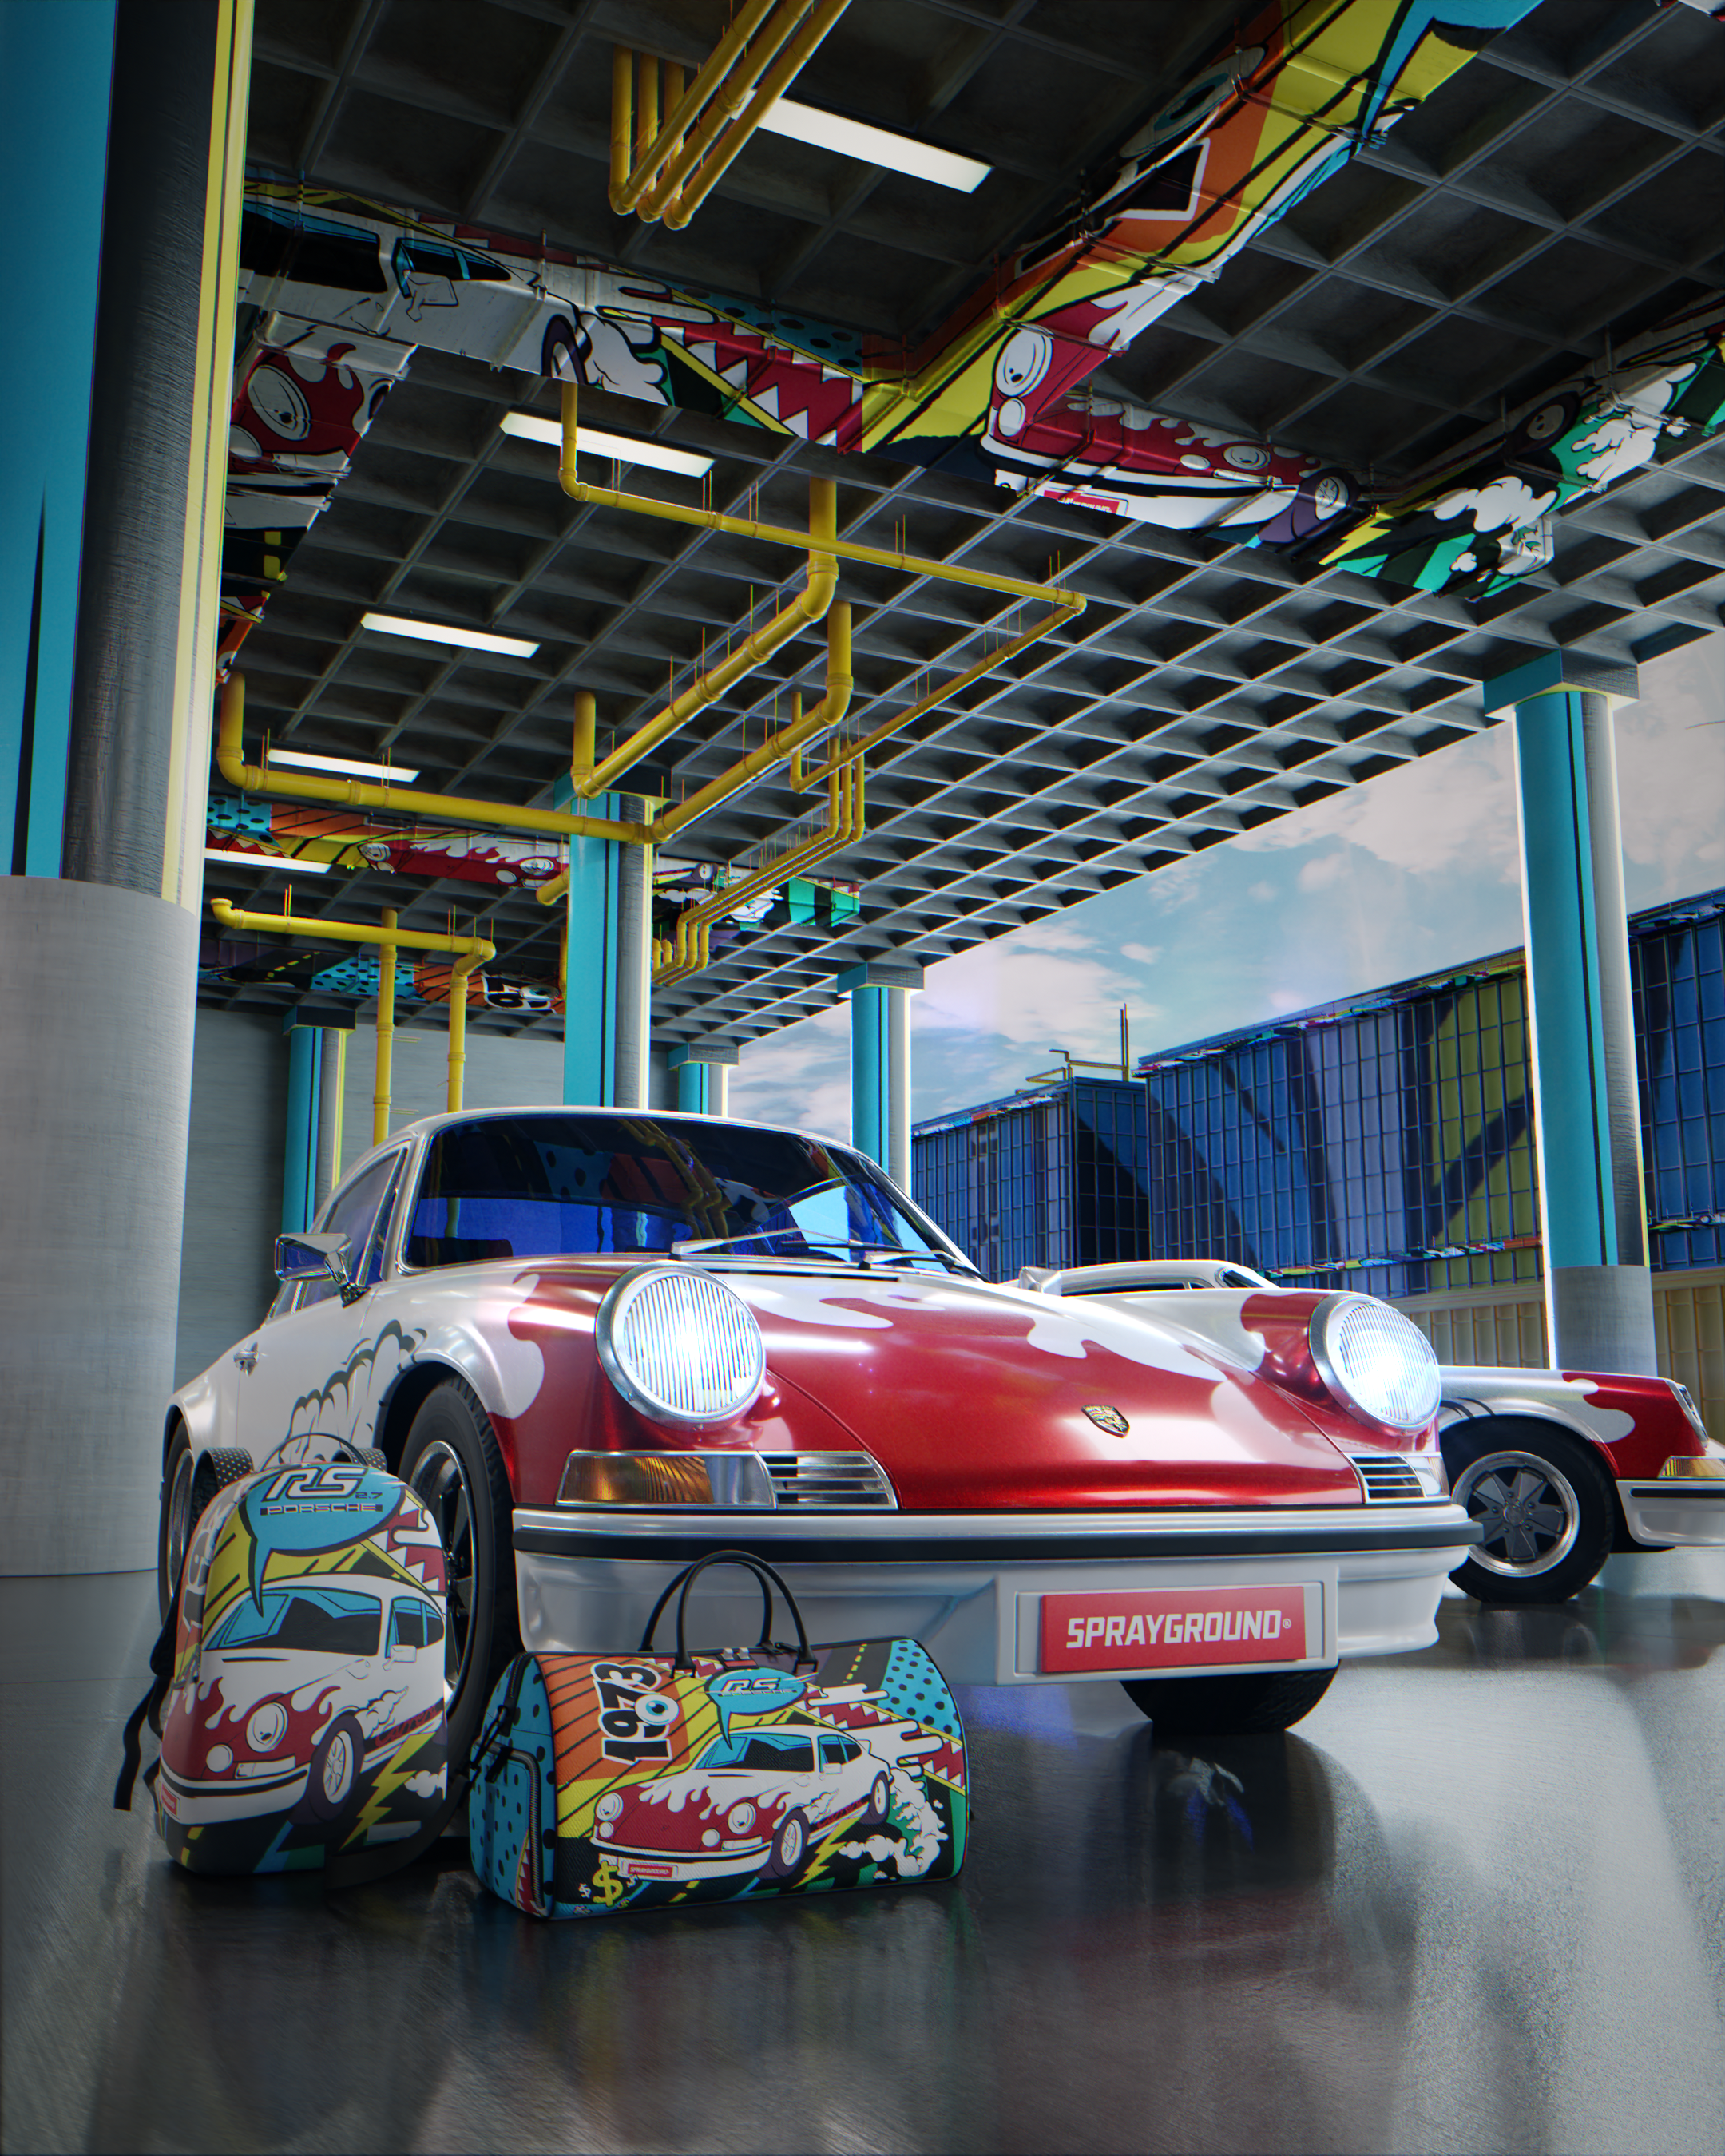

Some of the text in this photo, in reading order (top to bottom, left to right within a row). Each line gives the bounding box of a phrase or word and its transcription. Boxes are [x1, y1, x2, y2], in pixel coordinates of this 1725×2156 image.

[261, 1467, 368, 1502] RS
[266, 1502, 379, 1516] PORSCHE
[720, 1678, 780, 1692] RS
[590, 1662, 672, 1766] 1973
